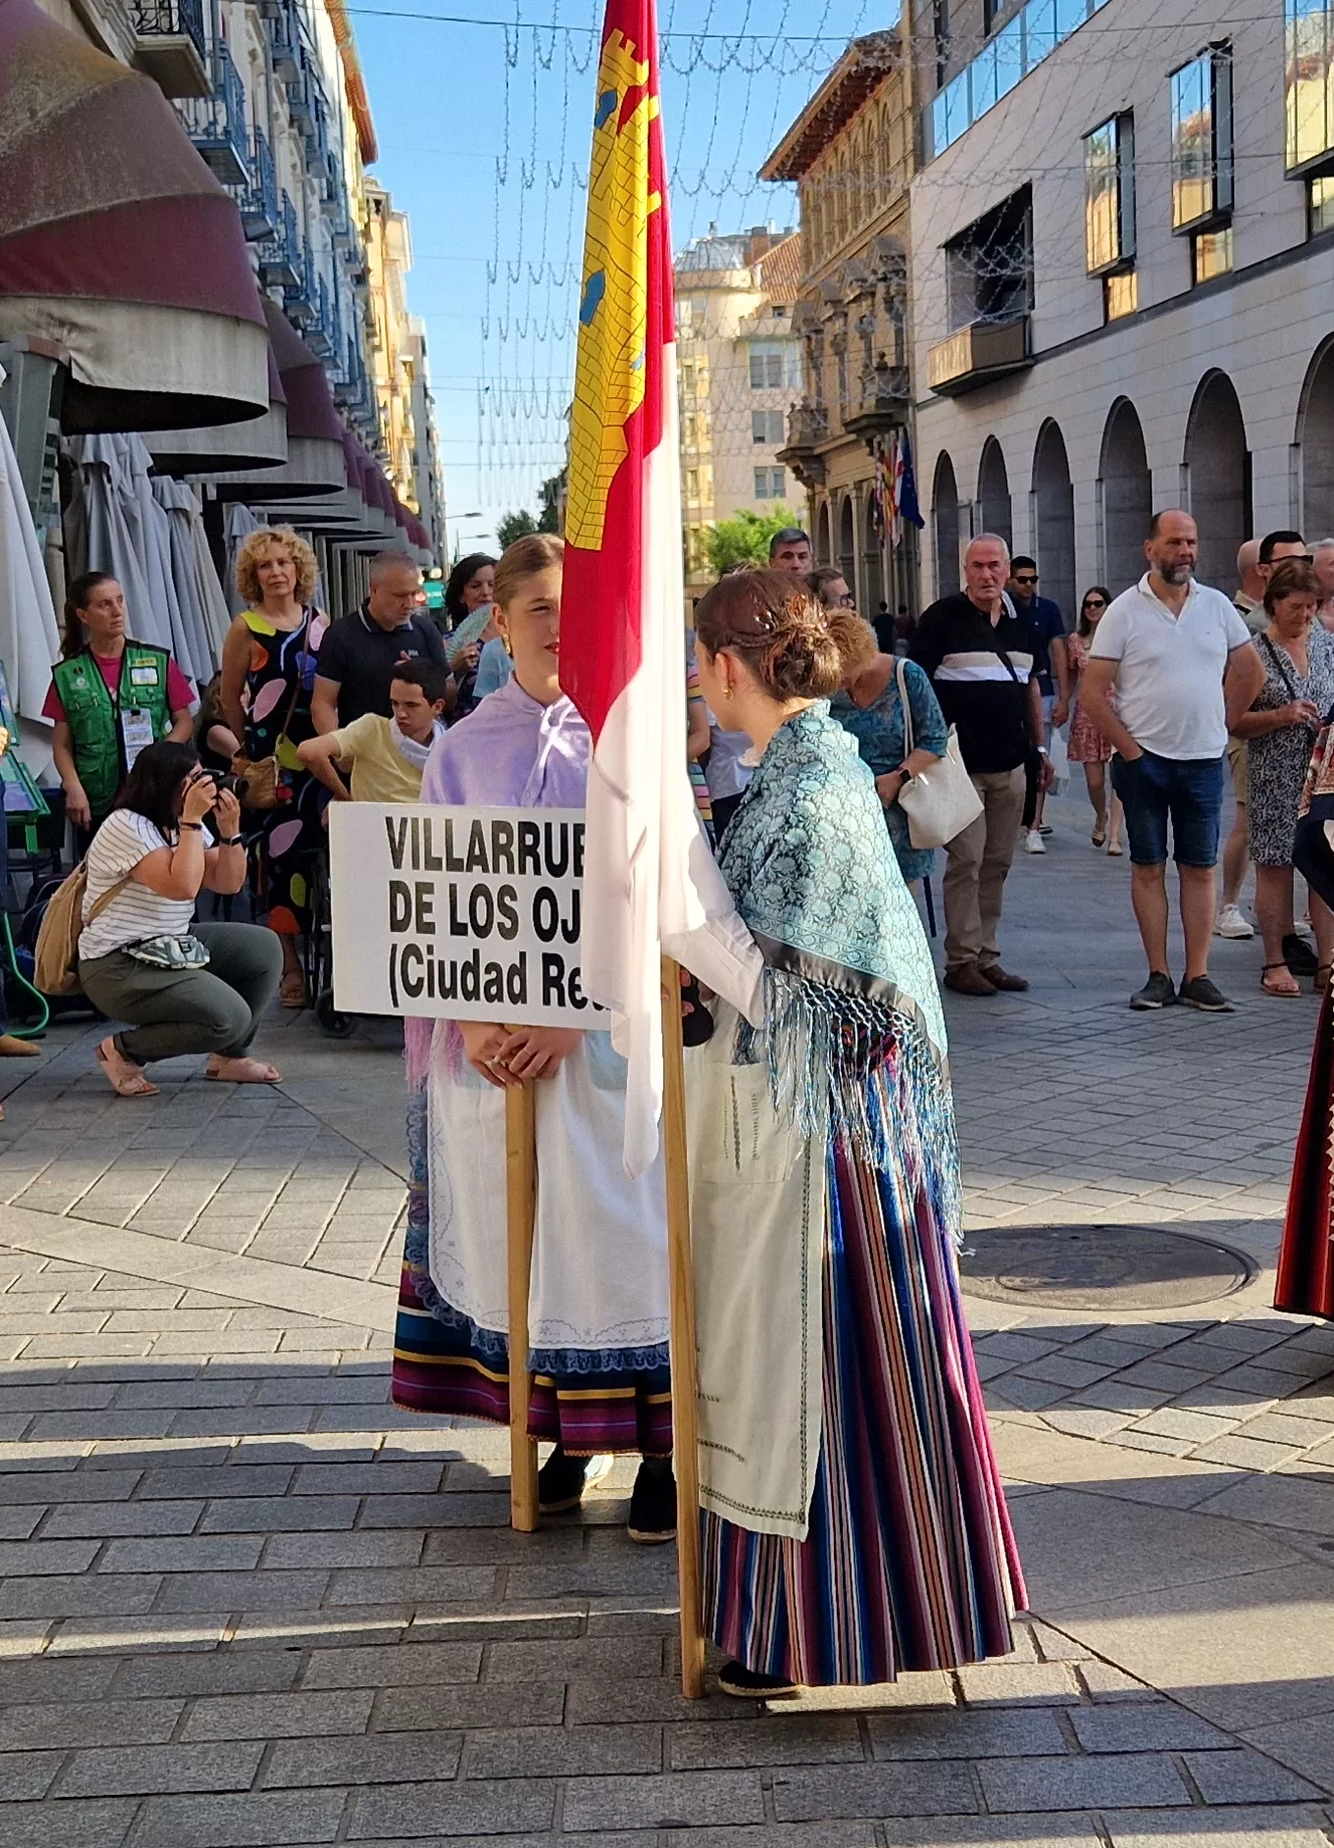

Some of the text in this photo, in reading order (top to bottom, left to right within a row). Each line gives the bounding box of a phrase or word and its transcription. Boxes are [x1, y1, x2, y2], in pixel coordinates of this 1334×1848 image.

[385, 816, 585, 877] VILLARRUE
[389, 880, 581, 944] DE LOS OJ
[389, 943, 611, 1011] (Ciudad Re
